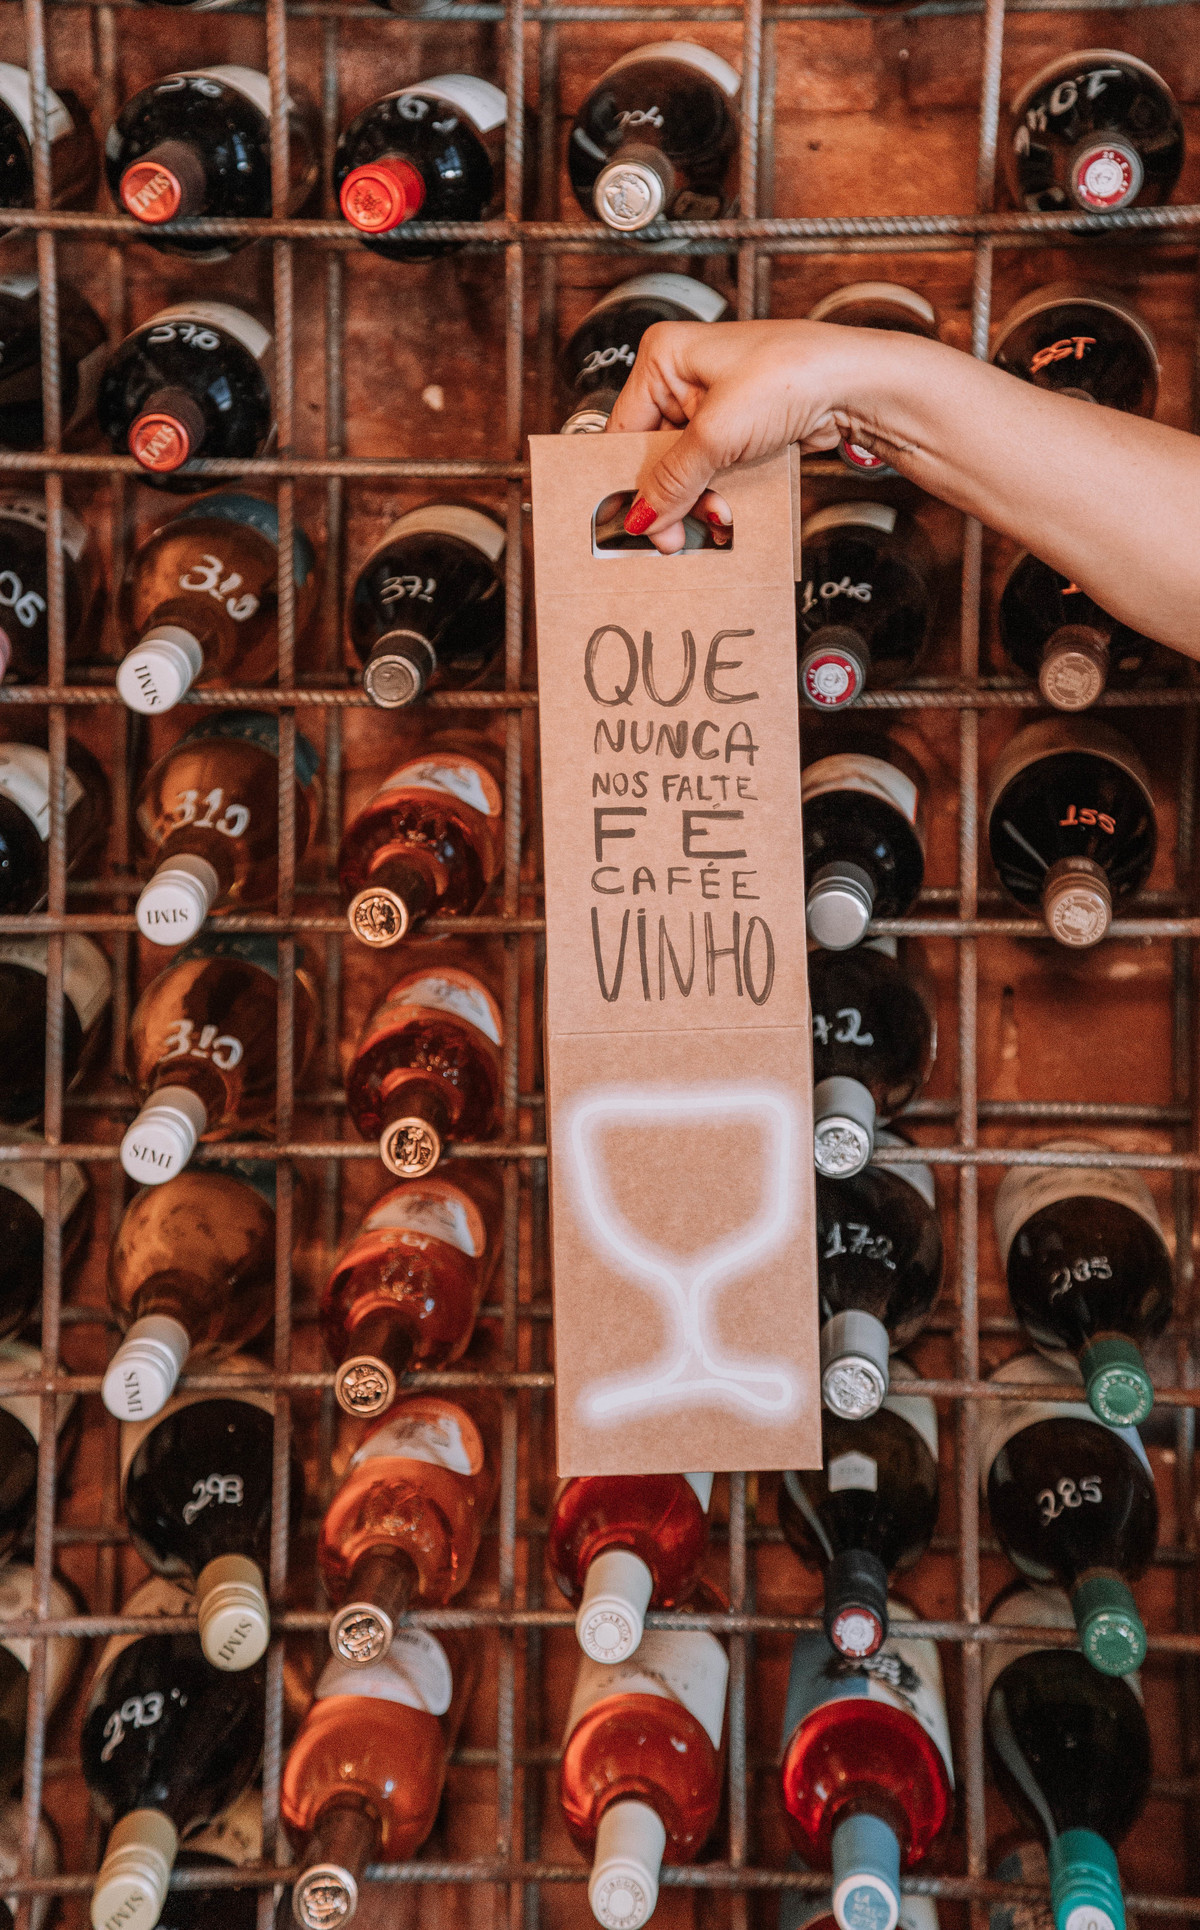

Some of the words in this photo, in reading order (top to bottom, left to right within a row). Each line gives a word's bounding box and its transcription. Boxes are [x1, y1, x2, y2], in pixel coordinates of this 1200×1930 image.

[128, 172, 171, 214] SIMI
[140, 424, 176, 465] SIMI
[134, 665, 161, 706] SIMI
[584, 625, 759, 707] QUE
[594, 718, 759, 767] NUNCA
[592, 771, 649, 800] NOS
[662, 773, 758, 803] FALTE
[147, 908, 188, 925] SIMI
[129, 1142, 175, 1170] SIMI
[123, 1370, 143, 1414] SIMI
[183, 1473, 244, 1526] 293
[1038, 1475, 1102, 1527] 285
[218, 1619, 253, 1662] SIMI
[101, 1691, 164, 1762] 293
